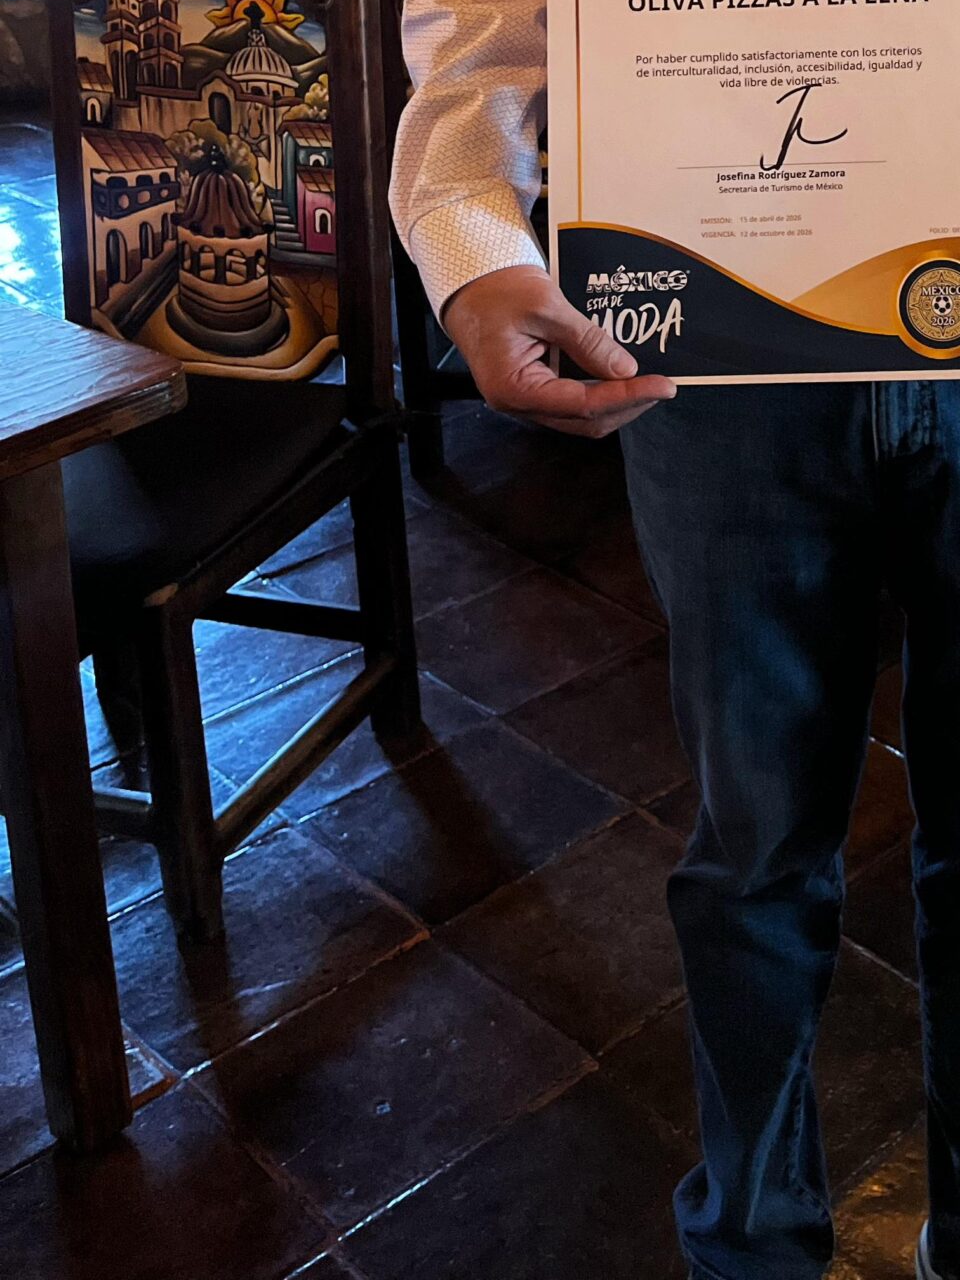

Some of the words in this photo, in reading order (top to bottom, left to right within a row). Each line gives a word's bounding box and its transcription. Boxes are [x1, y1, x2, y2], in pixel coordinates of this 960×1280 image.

[636, 55, 654, 65] Por
[657, 53, 687, 64] haber
[690, 52, 739, 64] cumplido
[741, 48, 838, 61] satisfactoriamente
[841, 50, 860, 58] con
[862, 48, 877, 57] los
[879, 46, 922, 57] criterios
[636, 67, 650, 78] de
[652, 64, 741, 78] interculturalidad,
[744, 63, 794, 75] inclusión,
[796, 60, 866, 73] accesibilidad,
[868, 59, 913, 72] igualdad
[916, 62, 922, 71] y
[720, 78, 741, 88] vida
[744, 77, 768, 87] libre
[770, 76, 783, 86] de
[786, 75, 839, 86] violencias.
[717, 172, 755, 183] Josefina
[758, 170, 806, 182] Rodríguez
[809, 169, 846, 179] Zamora
[719, 185, 758, 194] Secretaria
[760, 184, 769, 193] de
[771, 183, 802, 193] Turismo
[805, 182, 814, 191] de
[816, 182, 843, 191] México
[760, 215, 774, 223] abril
[785, 214, 802, 222] 2026
[796, 228, 813, 236] 2026
[587, 294, 609, 311] ESTÁ
[611, 293, 625, 307] DE
[931, 316, 955, 327] 2026
